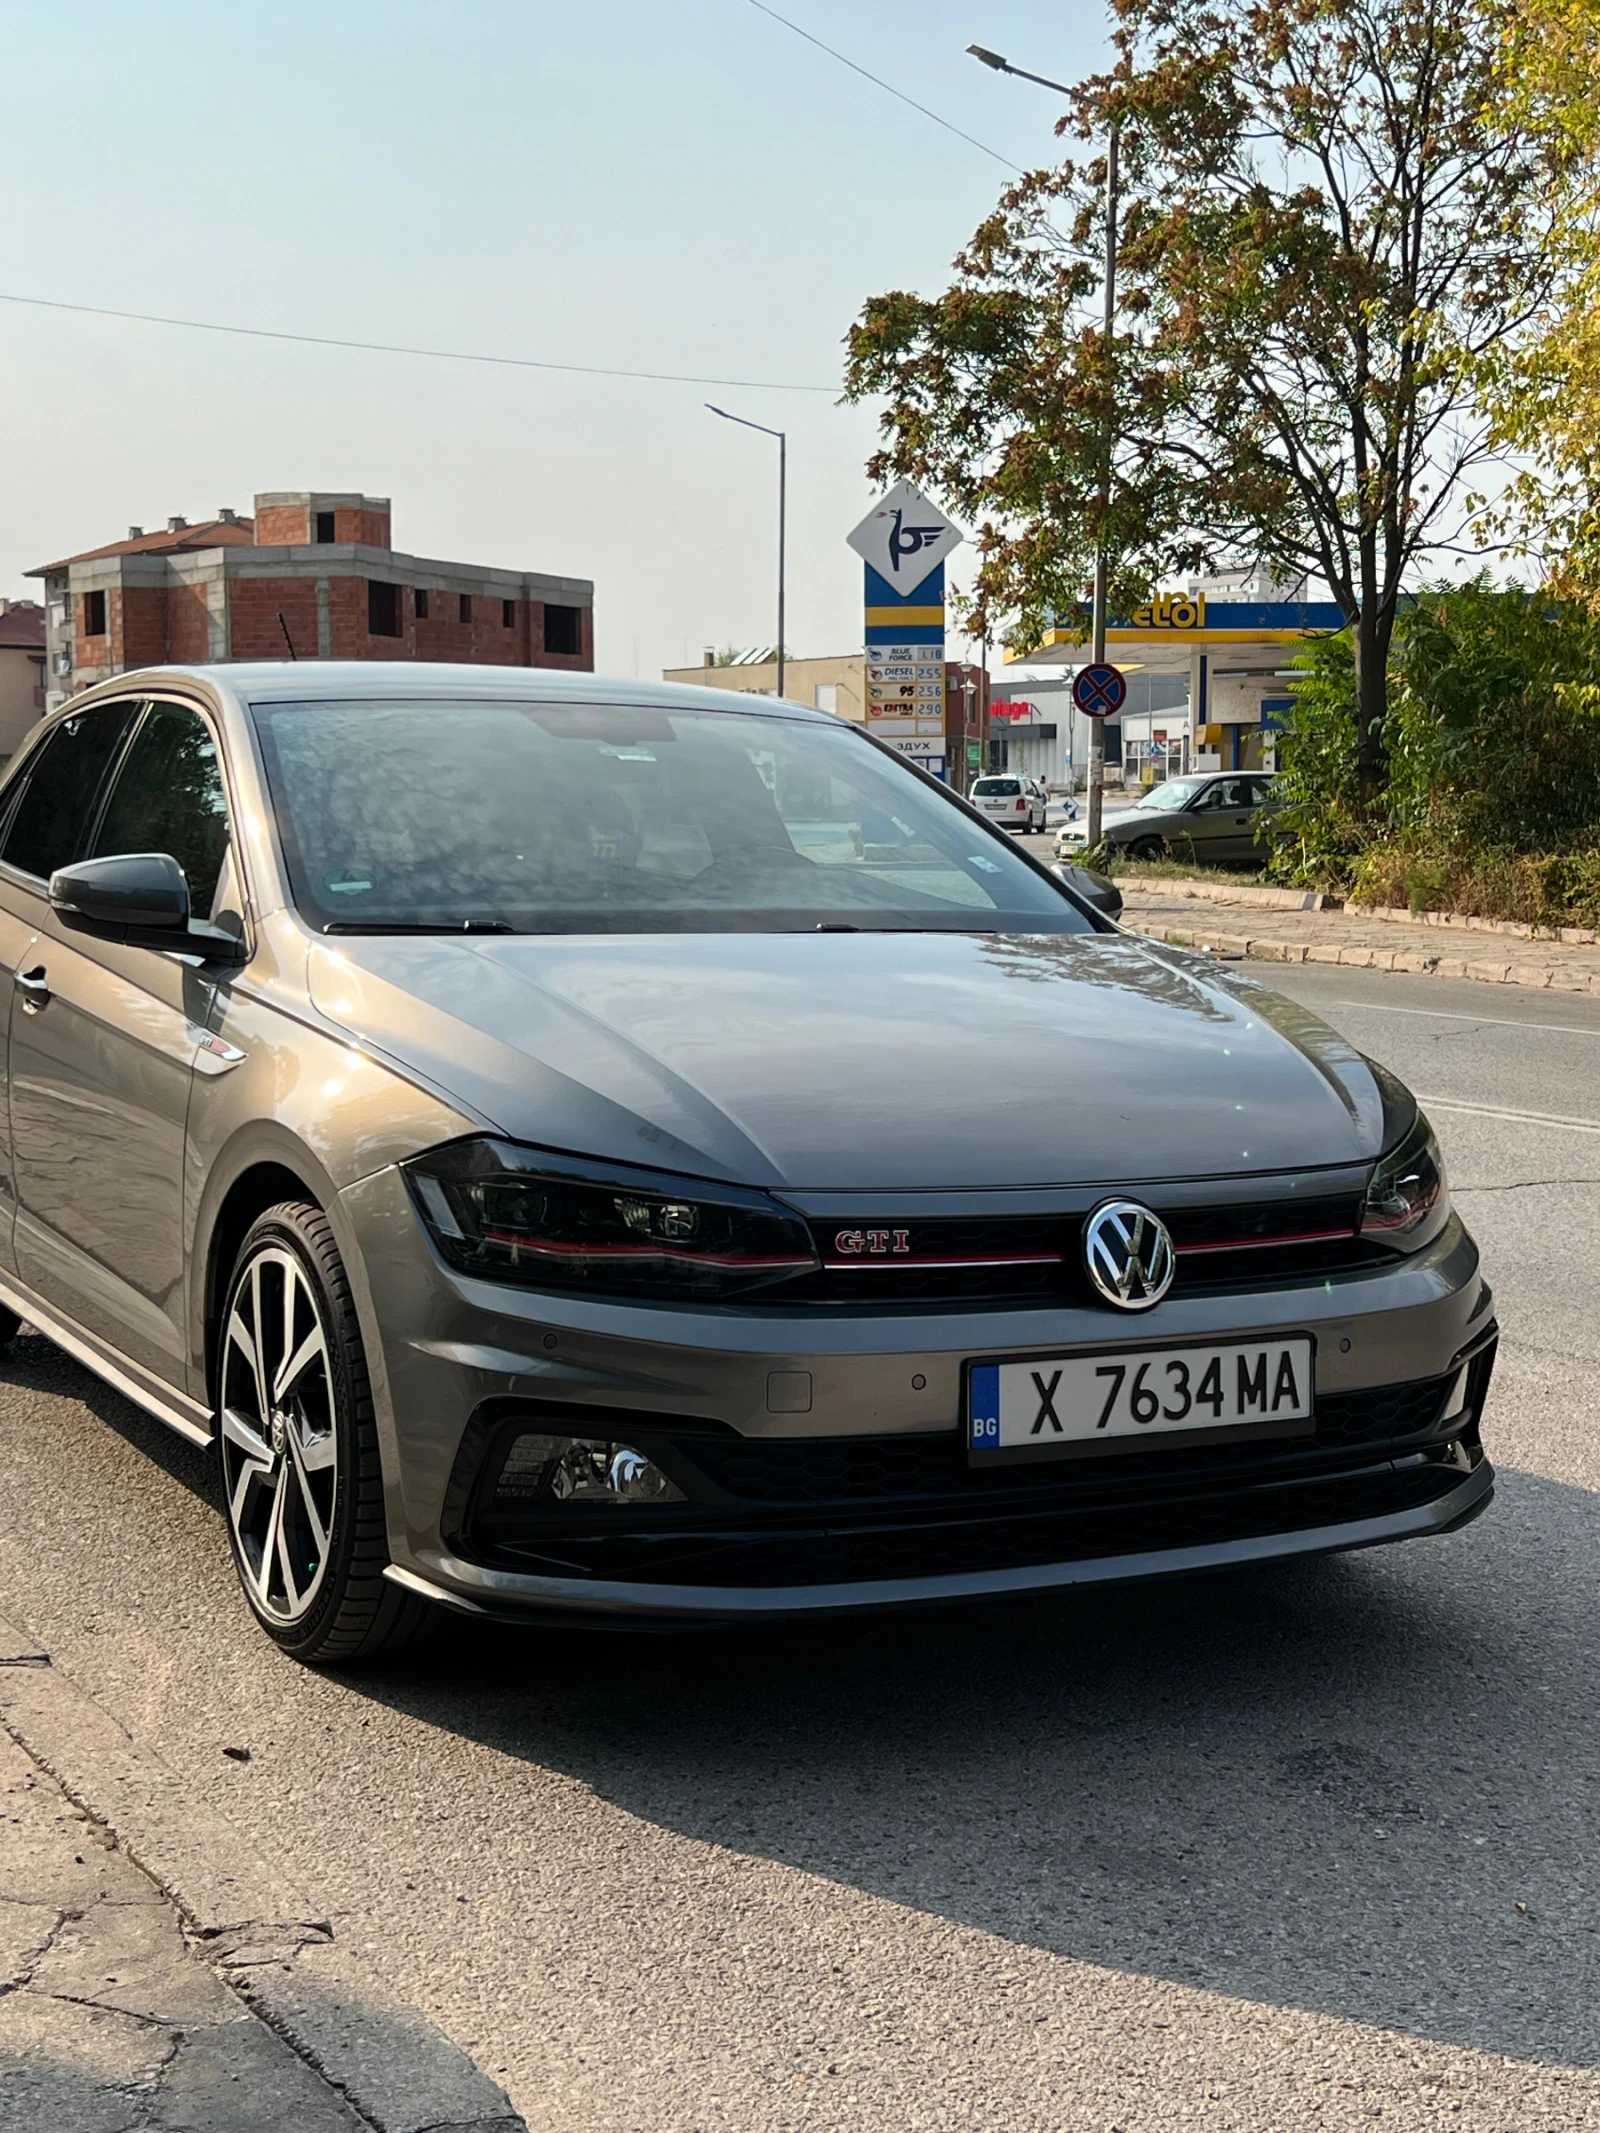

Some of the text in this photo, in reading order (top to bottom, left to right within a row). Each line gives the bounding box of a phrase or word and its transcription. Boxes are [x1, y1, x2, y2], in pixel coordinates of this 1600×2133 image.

[1132, 591, 1205, 628] etrol
[885, 667, 914, 676] DIESEL
[899, 685, 914, 697] 95
[894, 742, 930, 751] ЗДУХ
[835, 1229, 910, 1254] GTI
[1030, 1350, 1301, 1435] X 7634 MA
[973, 1418, 998, 1438] BG
